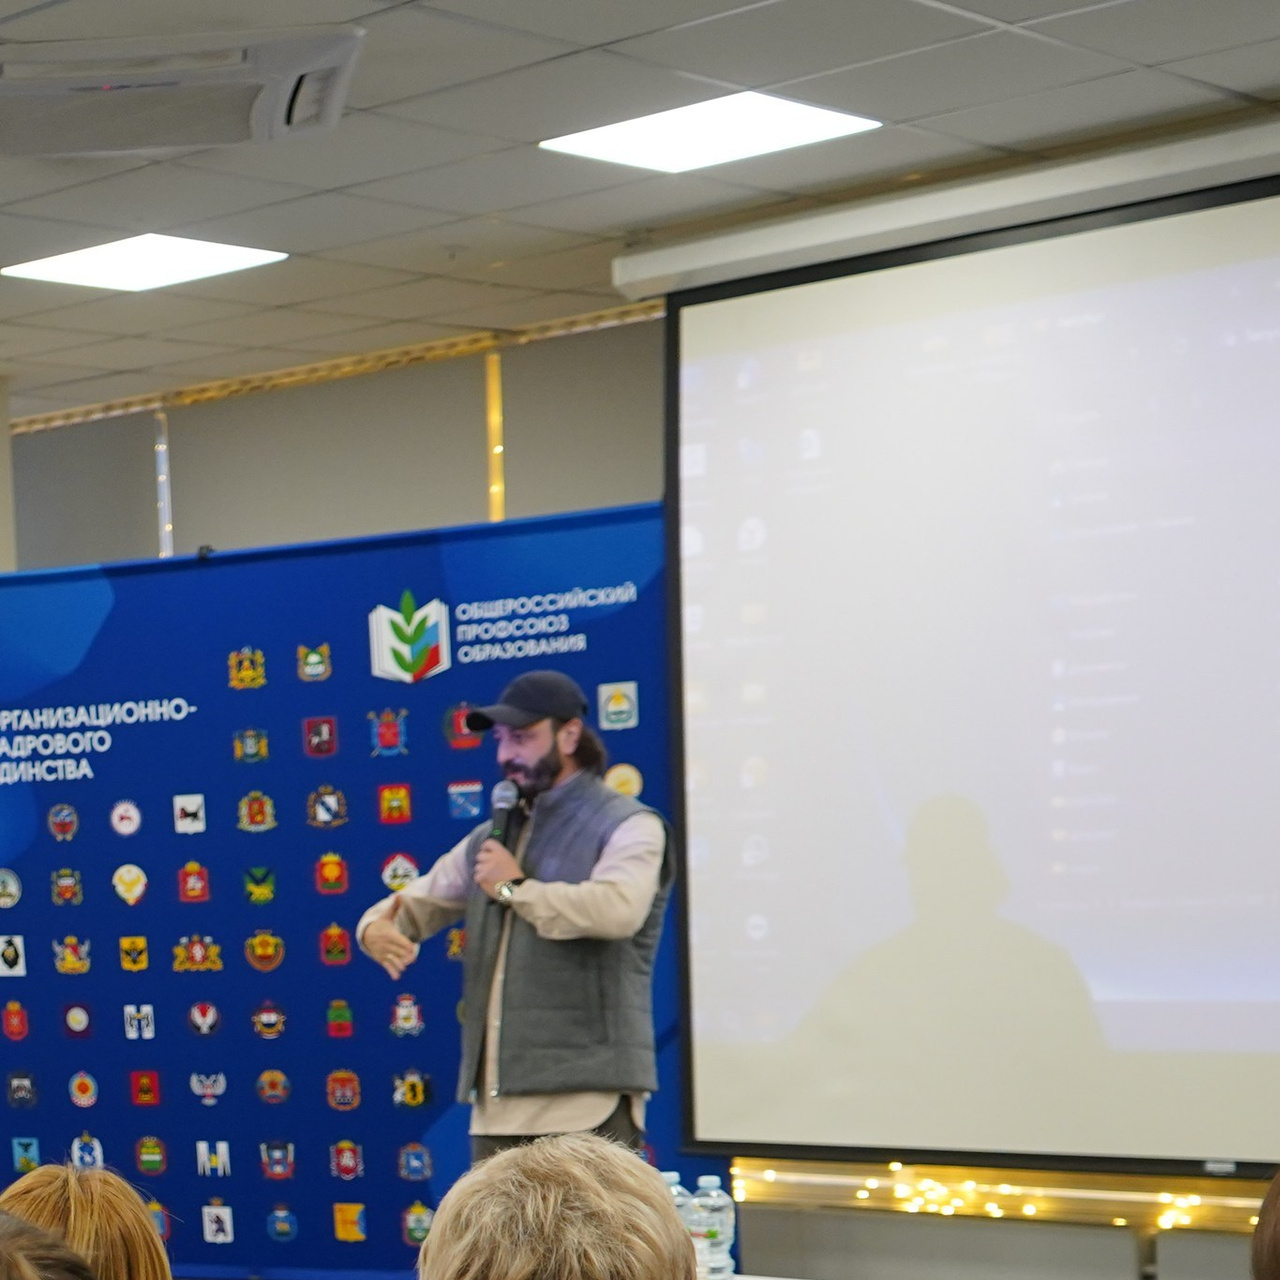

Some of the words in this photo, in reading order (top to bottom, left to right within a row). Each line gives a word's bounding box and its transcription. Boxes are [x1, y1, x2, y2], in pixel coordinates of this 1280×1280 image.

[456, 582, 637, 620] ОБЩЕРОССИЙСКИЙ
[456, 614, 569, 642] ПРОФСОЮЗ
[458, 634, 586, 663] ОБРАЗОВАНИЯ
